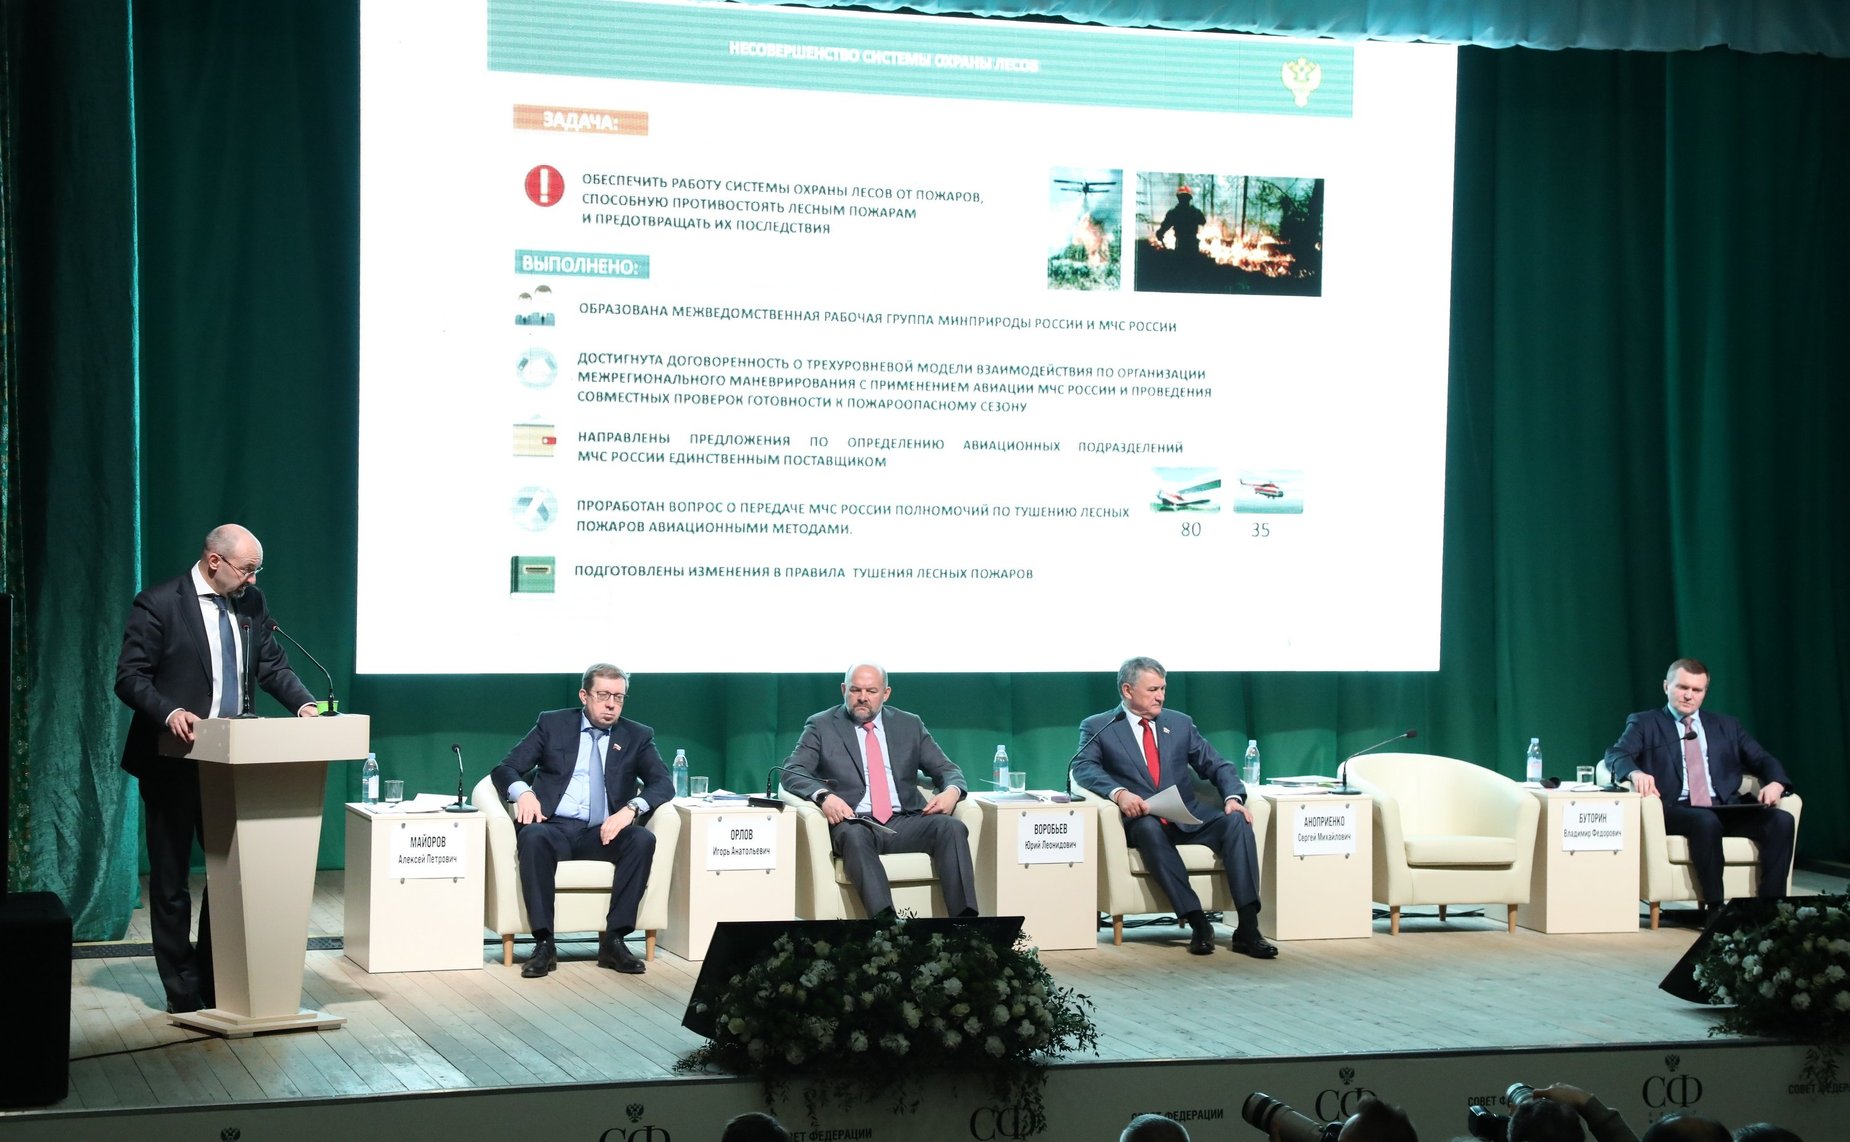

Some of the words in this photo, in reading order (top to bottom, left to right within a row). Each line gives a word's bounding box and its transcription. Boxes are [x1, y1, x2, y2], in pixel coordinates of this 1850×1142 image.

[729, 40, 860, 63] НЕСОВЕРШЕНСТВО
[863, 49, 932, 67] СИСТЕМЫ
[935, 53, 991, 70] ОХРАНЫ
[992, 57, 1040, 73] ЛЕСОВ
[542, 110, 619, 132] ЗАДАЧА:
[581, 173, 668, 188] ОБЕСПЕЧИТЬ
[671, 177, 722, 191] РАБОТУ
[725, 180, 790, 194] СИСТЕМЫ
[793, 183, 848, 197] ОХРАНЫ
[851, 186, 893, 199] ЛЕСОВ
[896, 188, 913, 200] ОТ
[916, 189, 984, 205] ПОЖАРОВ,
[581, 192, 669, 208] СПОСОБНУЮ
[672, 197, 785, 214] ПРОТИВОСТОЯТЬ
[788, 202, 846, 216] ЛЕСНЫМ
[849, 205, 917, 219] ПОЖАРАМ
[581, 212, 592, 224] И
[595, 213, 712, 231] ПРЕДОТВРАЩАТЬ
[714, 219, 732, 231] ИХ
[736, 219, 831, 235] ПОСЛЕДСТВИЯ
[521, 254, 639, 277] ВЫПОЛНЕНО:
[579, 302, 669, 317] ОБРАЗОВАНА
[671, 305, 820, 322] МЕЖВЕДОМСТВЕННАЯ
[824, 311, 883, 324] РАБОЧАЯ
[886, 313, 935, 325] ГРУППА
[937, 314, 1032, 331] МИНПРИРОДЫ
[1034, 318, 1083, 330] РОССИИ
[1086, 319, 1095, 330] И
[1098, 320, 1126, 332] МЧС
[1128, 320, 1177, 333] РОССИИ
[576, 351, 664, 366] ДОСТИГНУТА
[666, 354, 790, 370] ДОГОВОРЕННОСТЬ
[792, 358, 803, 370] О
[806, 358, 914, 373] ТРЕХУРОВНЕВОЙ
[916, 362, 973, 376] МОДЕЛИ
[976, 363, 1093, 379] ВЗАИМОДЕЙСТВИЯ
[1096, 367, 1115, 378] ПО
[1117, 367, 1206, 382] ОРГАНИЗАЦИИ
[577, 371, 726, 386] МЕЖРЕГИОНАЛЬНОГО
[729, 375, 856, 390] МАНЕВРИРОВАНИЯ
[859, 379, 867, 390] С
[870, 379, 970, 393] ПРИМЕНЕНИЕМ
[972, 382, 1034, 396] АВИАЦИИ
[1037, 383, 1065, 395] МЧС
[1067, 384, 1116, 396] РОССИИ
[1119, 386, 1129, 396] И
[1131, 385, 1212, 400] ПРОВЕДЕНИЯ
[576, 390, 670, 404] СОВМЕСТНЫХ
[673, 393, 744, 406] ПРОВЕРОК
[747, 394, 832, 408] ГОТОВНОСТИ
[835, 397, 843, 408] К
[847, 397, 977, 412] ПОЖАРООПАСНОМУ
[980, 400, 1028, 413] СЕЗОНУ
[578, 431, 671, 444] НАПРАВЛЕНЫ
[689, 433, 791, 447] ПРЕДЛОЖЕНИЯ
[809, 436, 829, 448] ПО
[847, 437, 945, 451] ОПРЕДЕЛЕНИЮ
[962, 439, 1061, 453] АВИАЦИОННЫХ
[1078, 441, 1184, 455] ПОДРАЗДЕЛЕНИЙ
[577, 450, 608, 463] МЧС
[610, 451, 665, 463] РОССИИ
[669, 452, 781, 466] ЕДИНСТВЕННЫМ
[783, 454, 887, 468] ПОСТАВЩИКОМ
[577, 499, 665, 513] ПРОРАБОТАН
[668, 500, 724, 514] ВОПРОС
[726, 501, 737, 514] О
[740, 502, 805, 517] ПЕРЕДАЧЕ
[808, 503, 838, 515] МЧС
[840, 503, 892, 516] РОССИИ
[895, 503, 990, 517] ПОЛНОМОЧИЙ
[992, 506, 1011, 517] ПО
[1014, 506, 1078, 518] ТУШЕНИЮ
[1080, 507, 1130, 519] ЛЕСНЫХ
[576, 520, 645, 533] ПОЖАРОВ
[648, 521, 769, 535] АВИАЦИОННЫМИ
[772, 523, 853, 537] МЕТОДАМИ.
[1180, 521, 1202, 537] 80
[1251, 522, 1270, 538] 35
[574, 565, 685, 579] ПОДГОТОВЛЕНЫ
[688, 565, 770, 578] ИЗМЕНЕНИЯ
[773, 566, 782, 578] В
[785, 567, 846, 578] ПРАВИЛА
[852, 567, 913, 579] ТУШЕНИЯ
[916, 568, 968, 579] ЛЕСНЫХ
[970, 568, 1034, 580] ПОЖАРОВ
[1303, 816, 1345, 827] АНОПРИЕНКО
[1579, 813, 1607, 823] БУТОРИН
[730, 829, 754, 840] ОРЛОВ
[1033, 823, 1068, 834] ВОРОБЬЕВ
[1564, 829, 1591, 838] Владимир
[1592, 829, 1622, 838] Федорович
[410, 834, 447, 847] МАЙОРОВ
[1024, 841, 1041, 851] Юрий
[1041, 840, 1077, 849] Леонидович
[1297, 833, 1317, 842] Сергей
[398, 855, 426, 863] Алексей
[426, 854, 457, 863] Петрович
[712, 848, 731, 856] Игорь
[731, 847, 771, 855] Анатольевич
[1642, 1074, 1703, 1109] СФ
[1467, 1095, 1496, 1107] СОВЕТ
[1164, 1108, 1224, 1122] ФЕДЕРАЦИИ
[808, 1127, 873, 1142] ФЕДЕРАЦИИ
